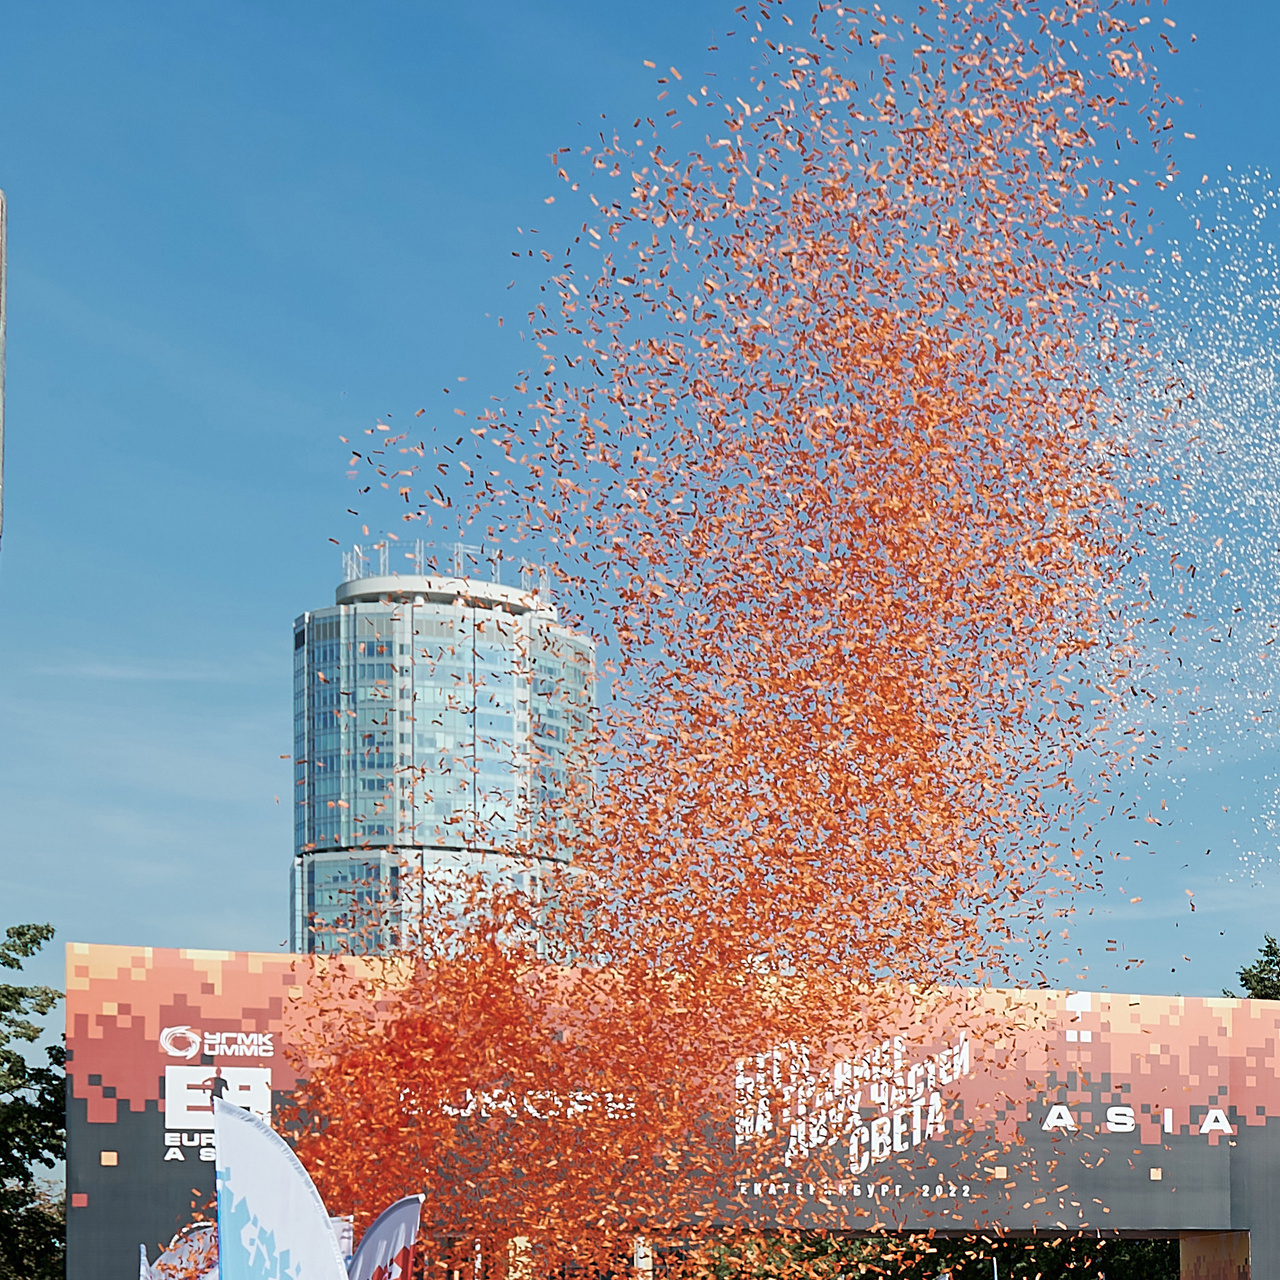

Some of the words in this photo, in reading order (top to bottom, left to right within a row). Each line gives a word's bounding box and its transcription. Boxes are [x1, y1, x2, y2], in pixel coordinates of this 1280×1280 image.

[204, 1032, 274, 1045] УГМК
[204, 1044, 275, 1057] UMMC
[1041, 1105, 1233, 1134] ASIA
[164, 1132, 216, 1147] EUR
[849, 1091, 947, 1175] СВЕТА
[164, 1147, 216, 1161] AS
[922, 1184, 971, 1198] 2022
